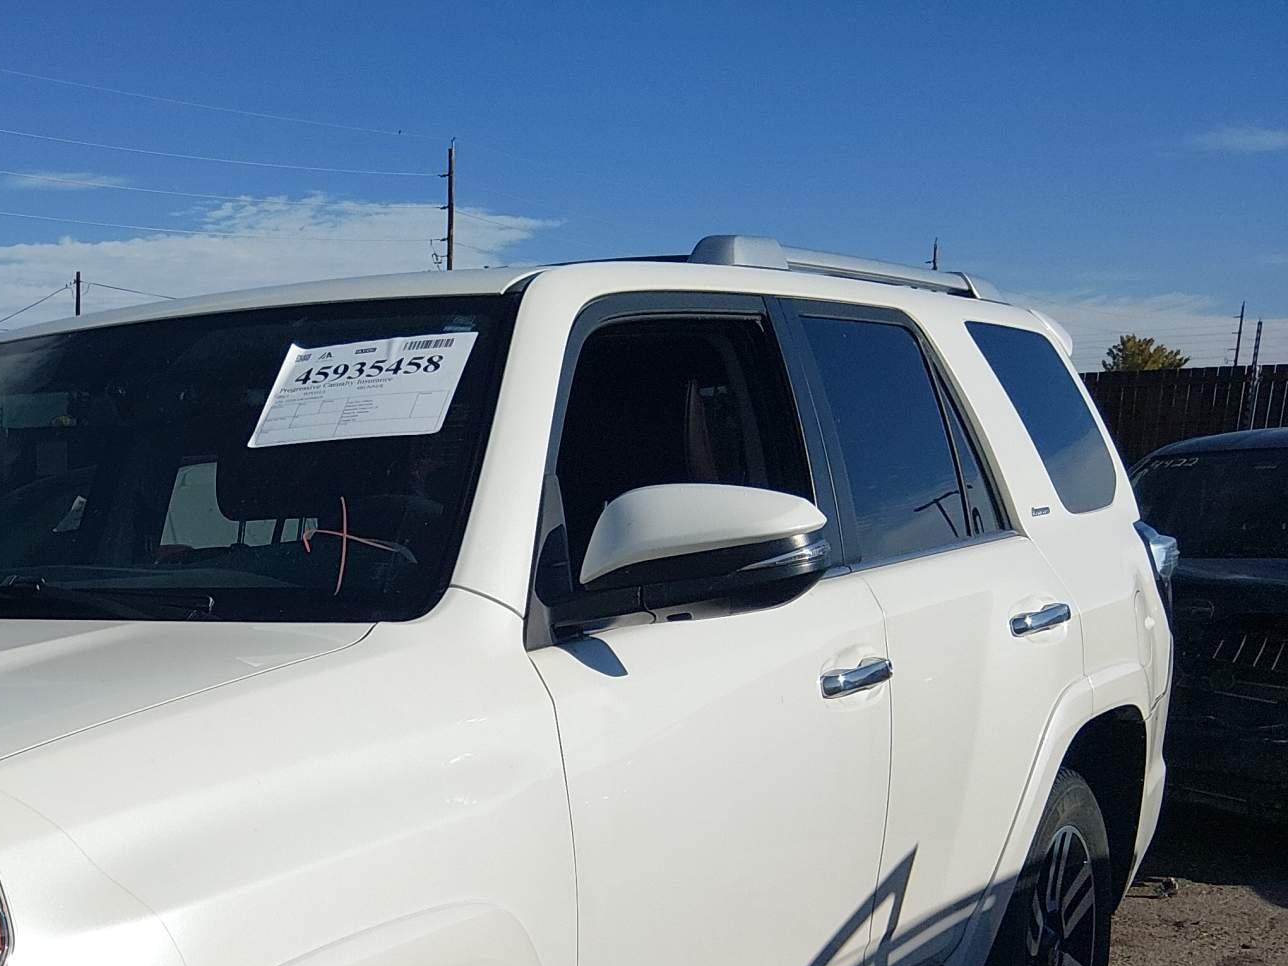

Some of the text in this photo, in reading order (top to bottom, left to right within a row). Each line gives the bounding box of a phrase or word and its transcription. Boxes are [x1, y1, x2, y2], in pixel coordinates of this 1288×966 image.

[295, 354, 444, 385] 45935458
[279, 384, 322, 394] Progressive
[323, 381, 354, 389] Casualty
[357, 377, 393, 385] Insurance
